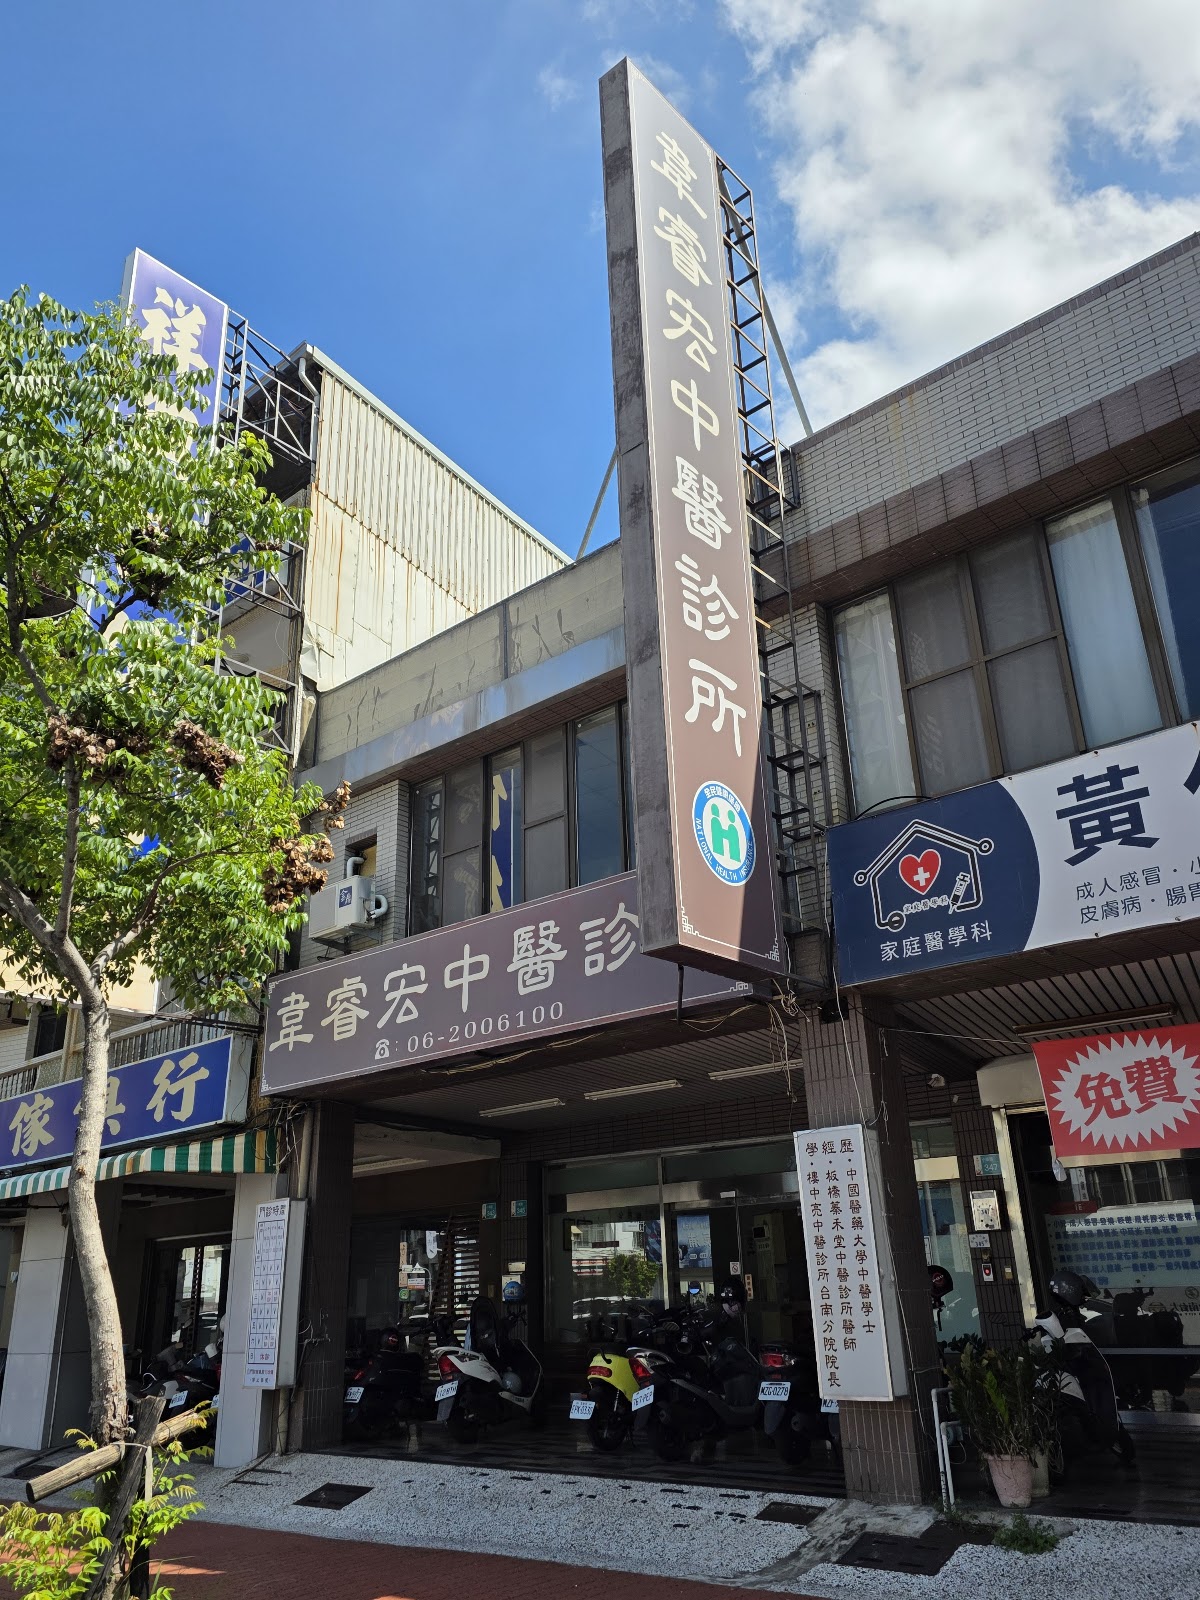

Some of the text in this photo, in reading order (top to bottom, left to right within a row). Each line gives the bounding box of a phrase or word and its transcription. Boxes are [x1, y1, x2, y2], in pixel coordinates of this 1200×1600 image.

[651, 131, 746, 758] 韋睿宏中醫診所
[696, 817, 753, 880] NATIONAL HEALTH INSURANCE
[880, 919, 993, 962] 家庭醫學科
[406, 1001, 564, 1053] 06-2006100
[1074, 1054, 1187, 1127] 免費
[984, 1163, 998, 1172] 347
